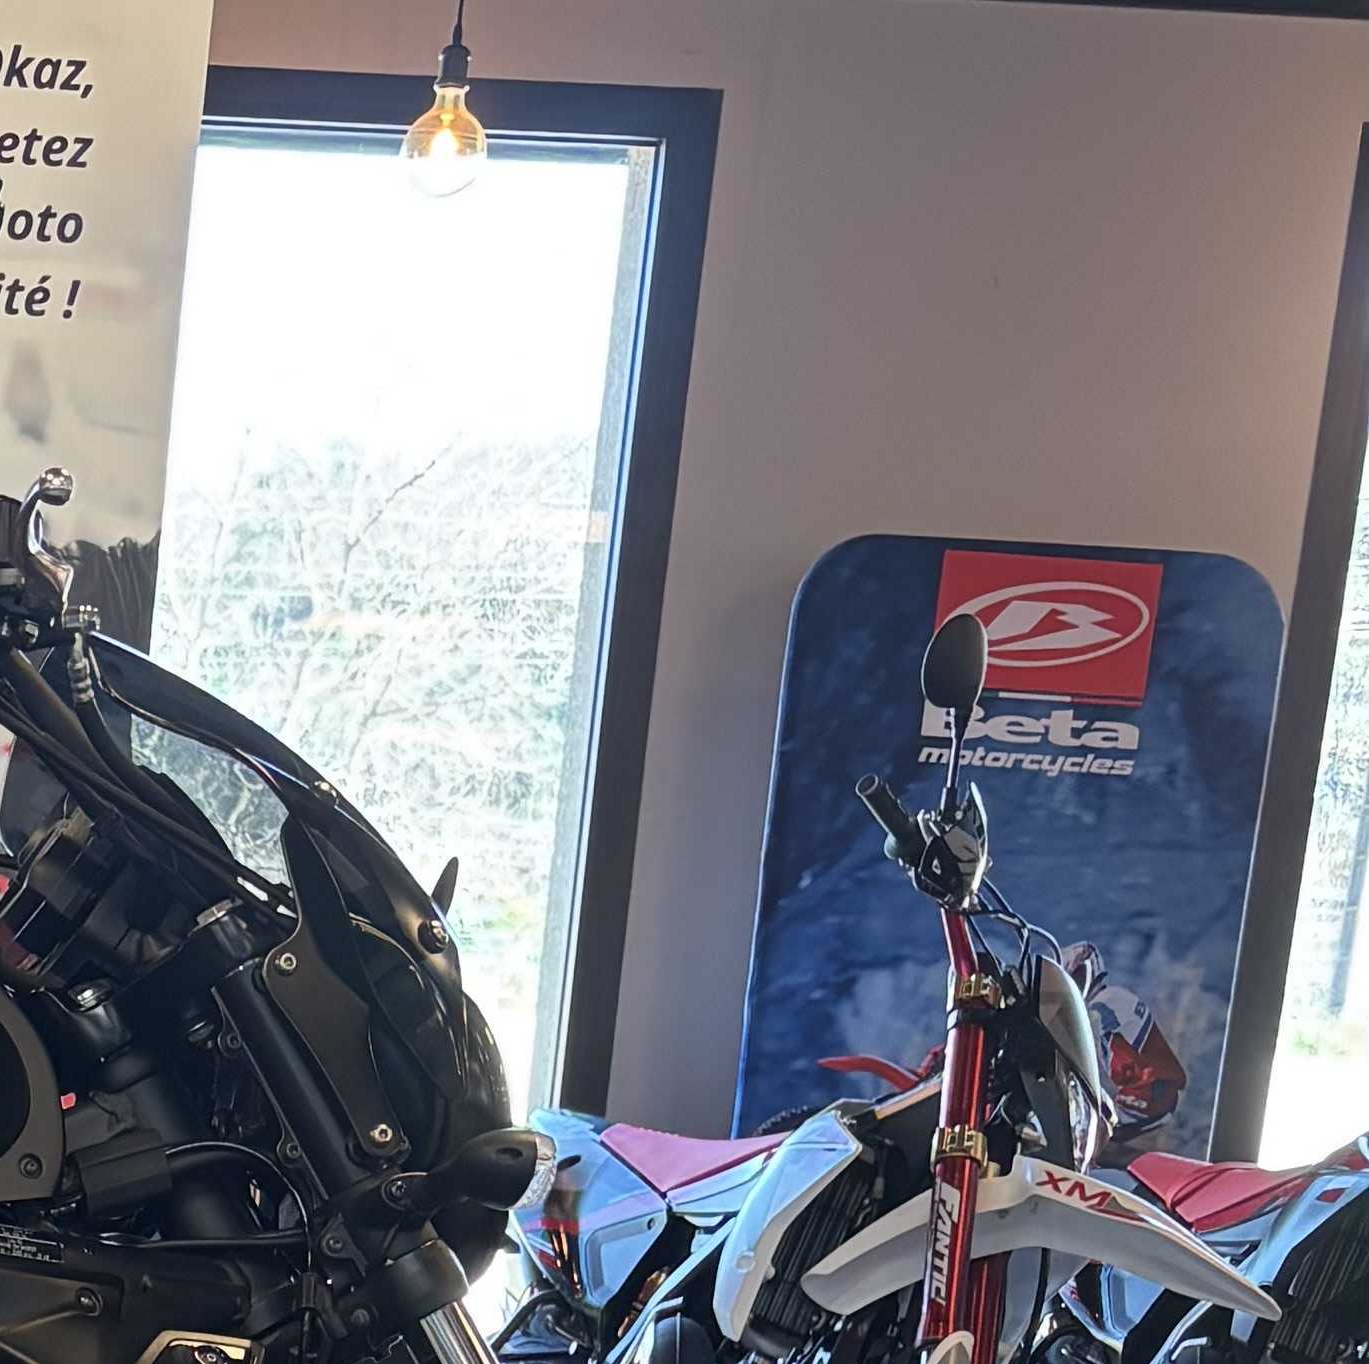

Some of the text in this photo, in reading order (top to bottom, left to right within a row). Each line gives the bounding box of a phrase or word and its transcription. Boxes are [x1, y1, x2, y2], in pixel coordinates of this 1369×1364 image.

[7, 205, 84, 243] oto
[1035, 1170, 1112, 1208] XM
[930, 1181, 961, 1307] FANTIC
